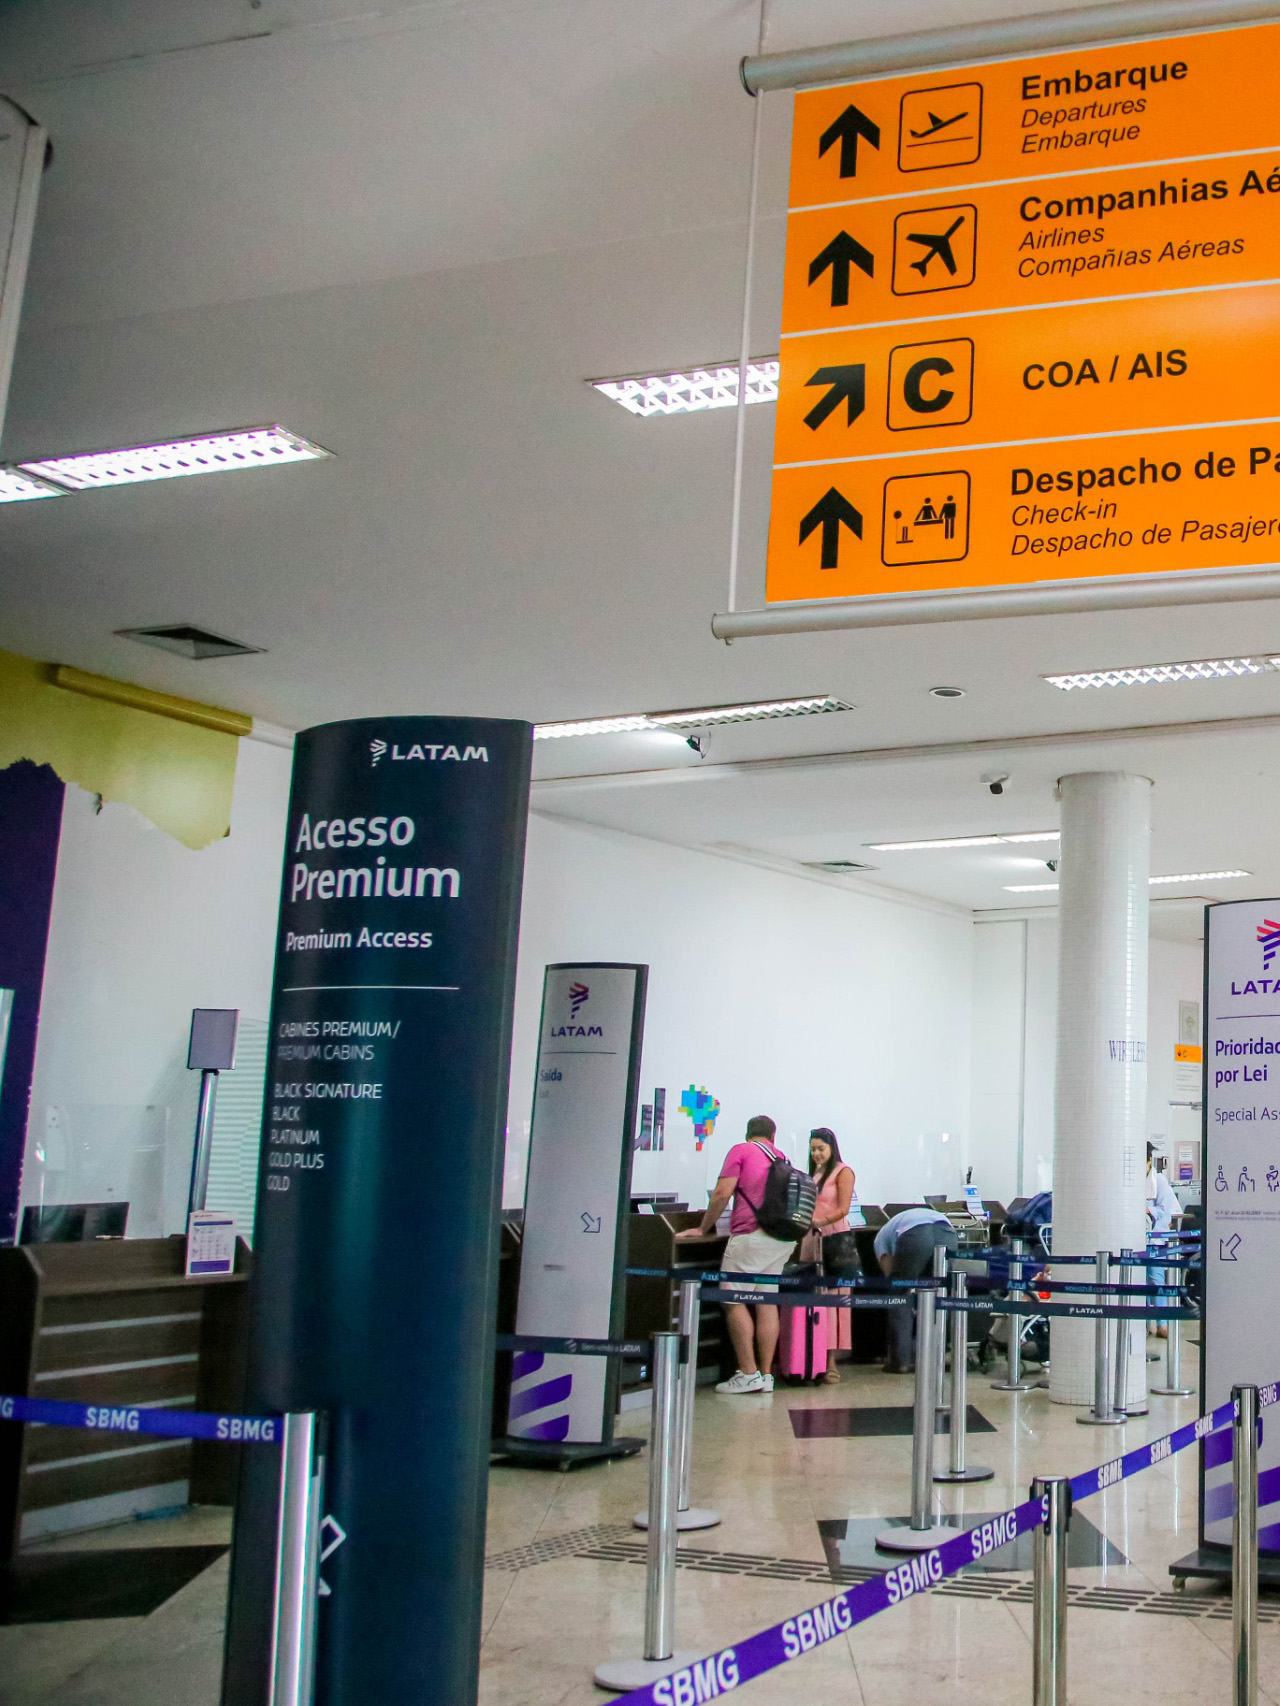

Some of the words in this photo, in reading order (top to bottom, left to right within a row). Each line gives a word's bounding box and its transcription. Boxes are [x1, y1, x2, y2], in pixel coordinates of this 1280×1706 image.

[1021, 61, 1188, 100] Embarque
[1021, 97, 1147, 128] Departures
[1021, 125, 1141, 154] Embarque
[1019, 177, 1229, 222] Companhias
[1018, 225, 1105, 252] Airlines
[1158, 237, 1245, 263] Aéreas
[1021, 357, 1101, 392] COA
[1109, 355, 1120, 384] /
[1127, 350, 1188, 382] AIS
[903, 357, 955, 415] C
[1011, 457, 1182, 498] Despacho
[1194, 451, 1236, 480] de
[1011, 498, 1118, 527] Check-in
[1010, 526, 1133, 557] Despacho
[1141, 523, 1172, 544] de
[391, 744, 489, 763] LATAM
[295, 813, 415, 853] Acesso
[291, 856, 461, 902] Premium
[286, 929, 351, 951] Premium
[356, 927, 433, 948] Access
[550, 1025, 603, 1038] LATAM
[323, 1044, 375, 1060] CABINS
[1214, 1066, 1239, 1088] por
[1243, 1064, 1268, 1082] Lei
[274, 1083, 302, 1099] BLACK
[304, 1083, 383, 1099] SIGNATURE
[272, 1106, 301, 1121] BLACK
[1214, 1106, 1257, 1125] Special
[270, 1129, 320, 1145] PLATINUM
[268, 1152, 292, 1168] GOLD
[293, 1153, 325, 1169] PLUS
[266, 1175, 291, 1191] GOLD
[701, 1271, 719, 1282] Azul
[837, 1277, 856, 1287] Azul
[1006, 1280, 1027, 1290] Azul
[1157, 1286, 1178, 1297] Azul
[740, 1293, 764, 1301] LATAM
[888, 1298, 907, 1306] LATAM
[974, 1301, 994, 1309] LATAM
[620, 1344, 641, 1353] LATAM
[1259, 1383, 1277, 1408] SBMG
[85, 1406, 140, 1432] SBMG
[216, 1417, 274, 1441] SBMG
[1194, 1413, 1213, 1440] SBMG
[1150, 1435, 1172, 1464] SBMG
[1097, 1458, 1123, 1490] SBMG
[971, 1510, 1018, 1560] SBMG
[885, 1549, 943, 1604] SBMG
[781, 1595, 852, 1660] SBMG
[651, 1647, 740, 1706] SBMG
